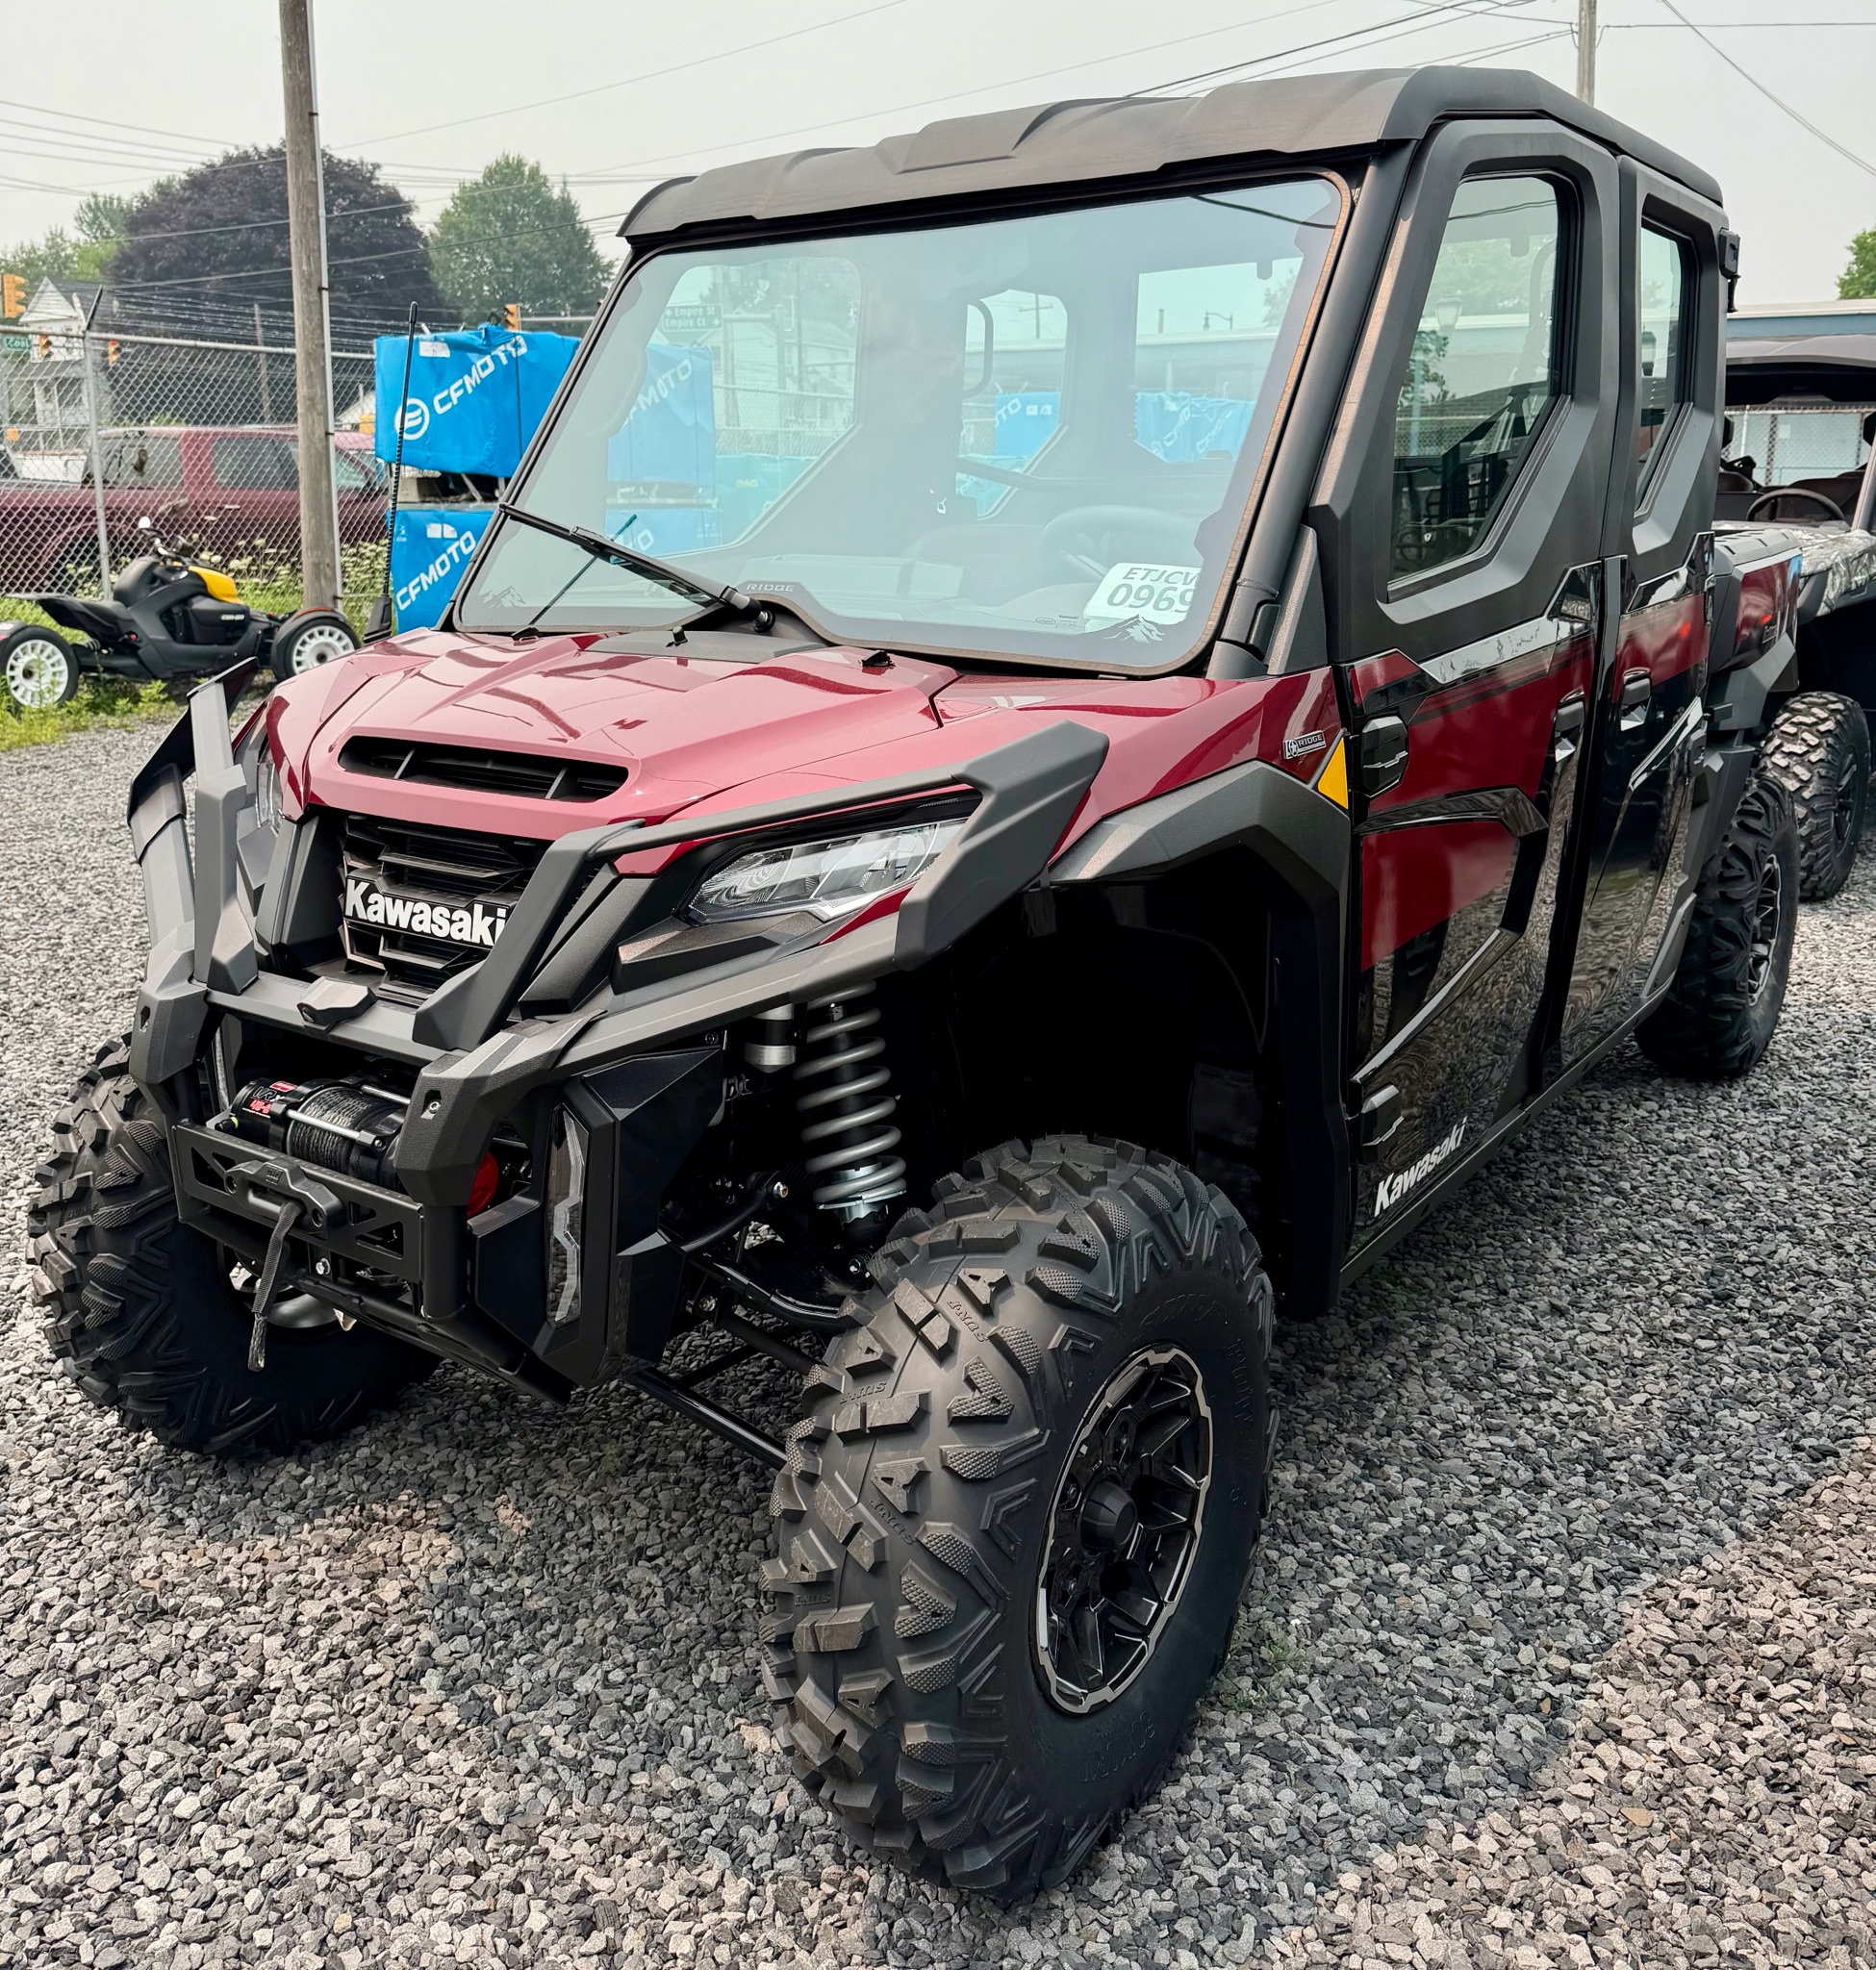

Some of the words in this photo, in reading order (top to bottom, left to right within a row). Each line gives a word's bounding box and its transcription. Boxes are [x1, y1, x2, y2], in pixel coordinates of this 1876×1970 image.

[665, 317, 694, 329] Empire
[674, 307, 704, 317] Empire
[433, 335, 528, 415] CFMOTO
[622, 359, 692, 428] MOTO
[395, 530, 476, 611] CFMOTO
[747, 583, 796, 593] RIDGE
[1299, 734, 1324, 747] RIDGE
[344, 878, 508, 947] Kawasaki
[1374, 1116, 1468, 1218] Kawasaki
